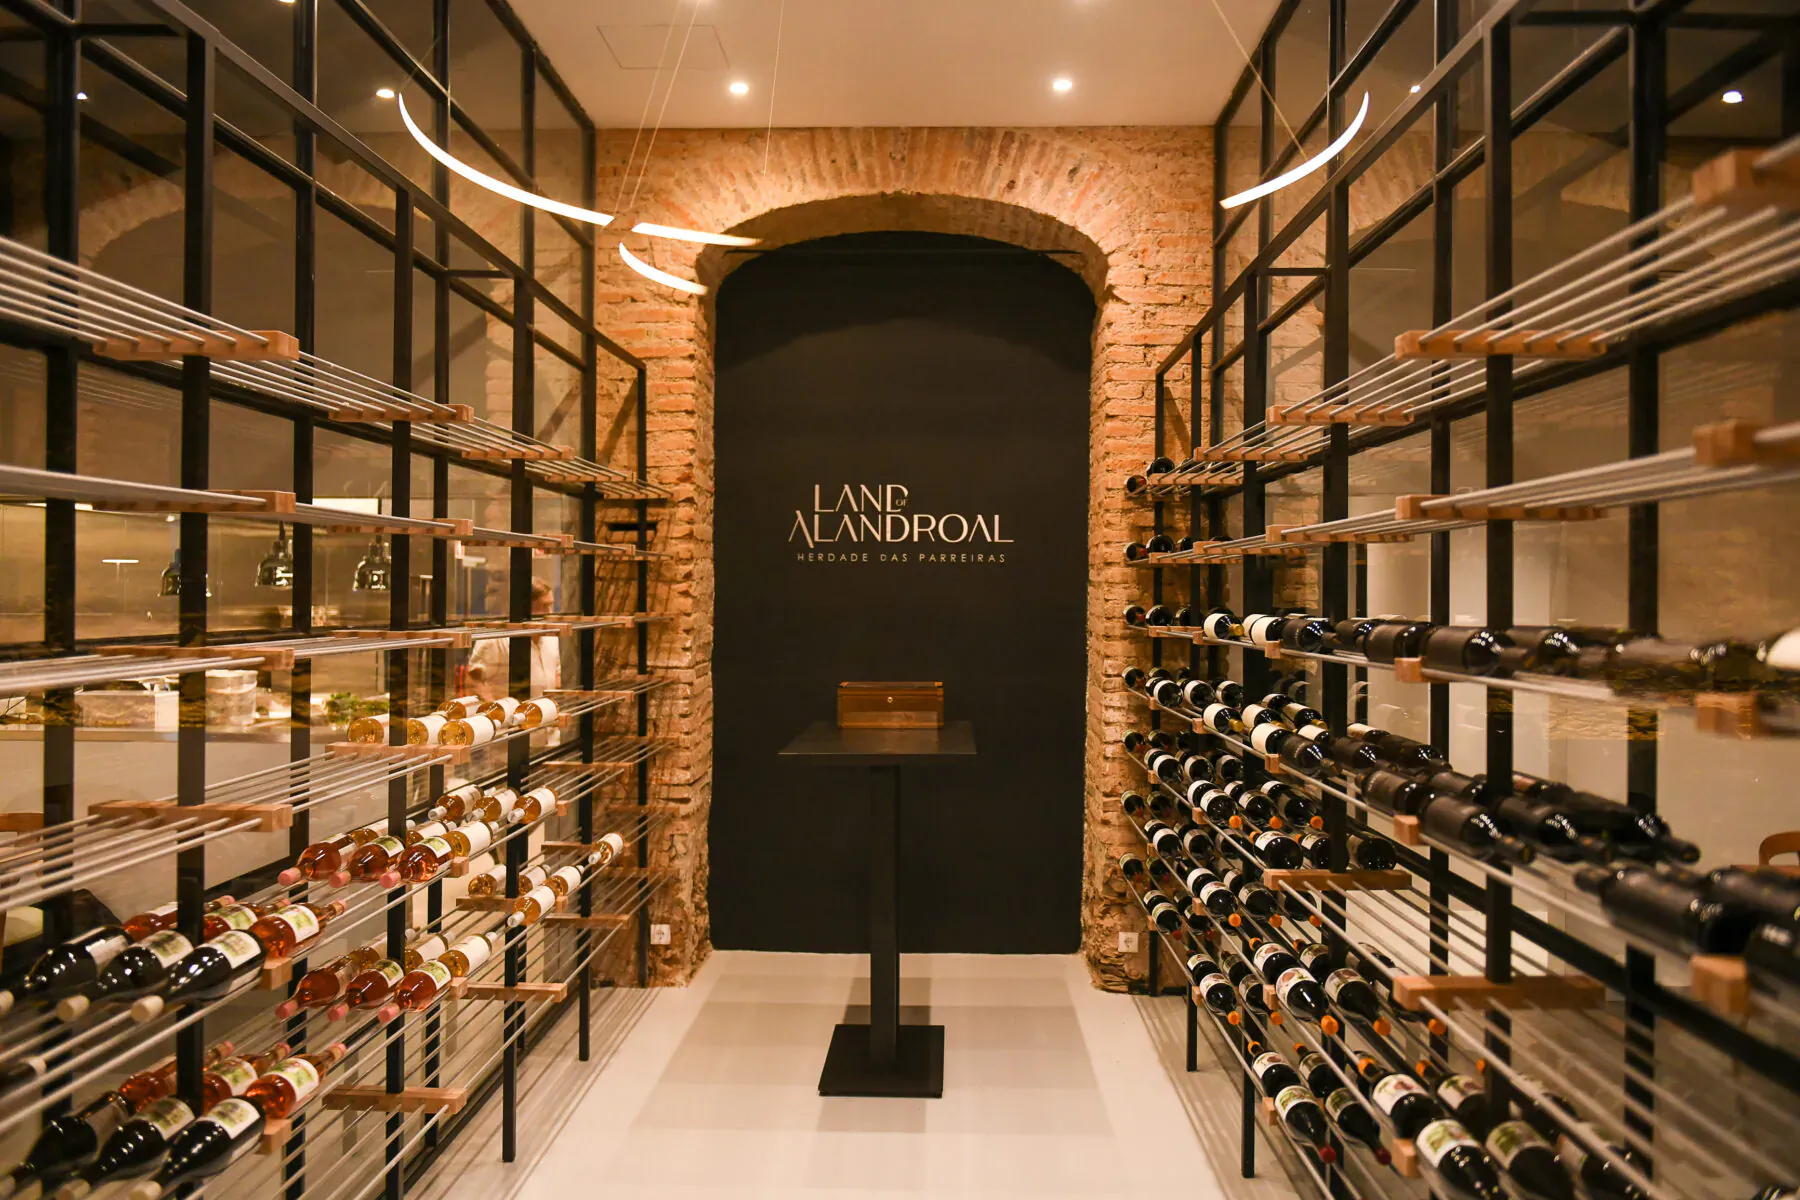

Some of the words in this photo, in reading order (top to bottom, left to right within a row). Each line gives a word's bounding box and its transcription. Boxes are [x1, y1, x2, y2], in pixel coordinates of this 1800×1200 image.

[814, 484, 909, 512] LAND
[788, 510, 1015, 549] ALANDROAL
[797, 553, 869, 563] HERDADE
[880, 553, 908, 563] DAS
[919, 553, 1005, 564] PARREIRAS
